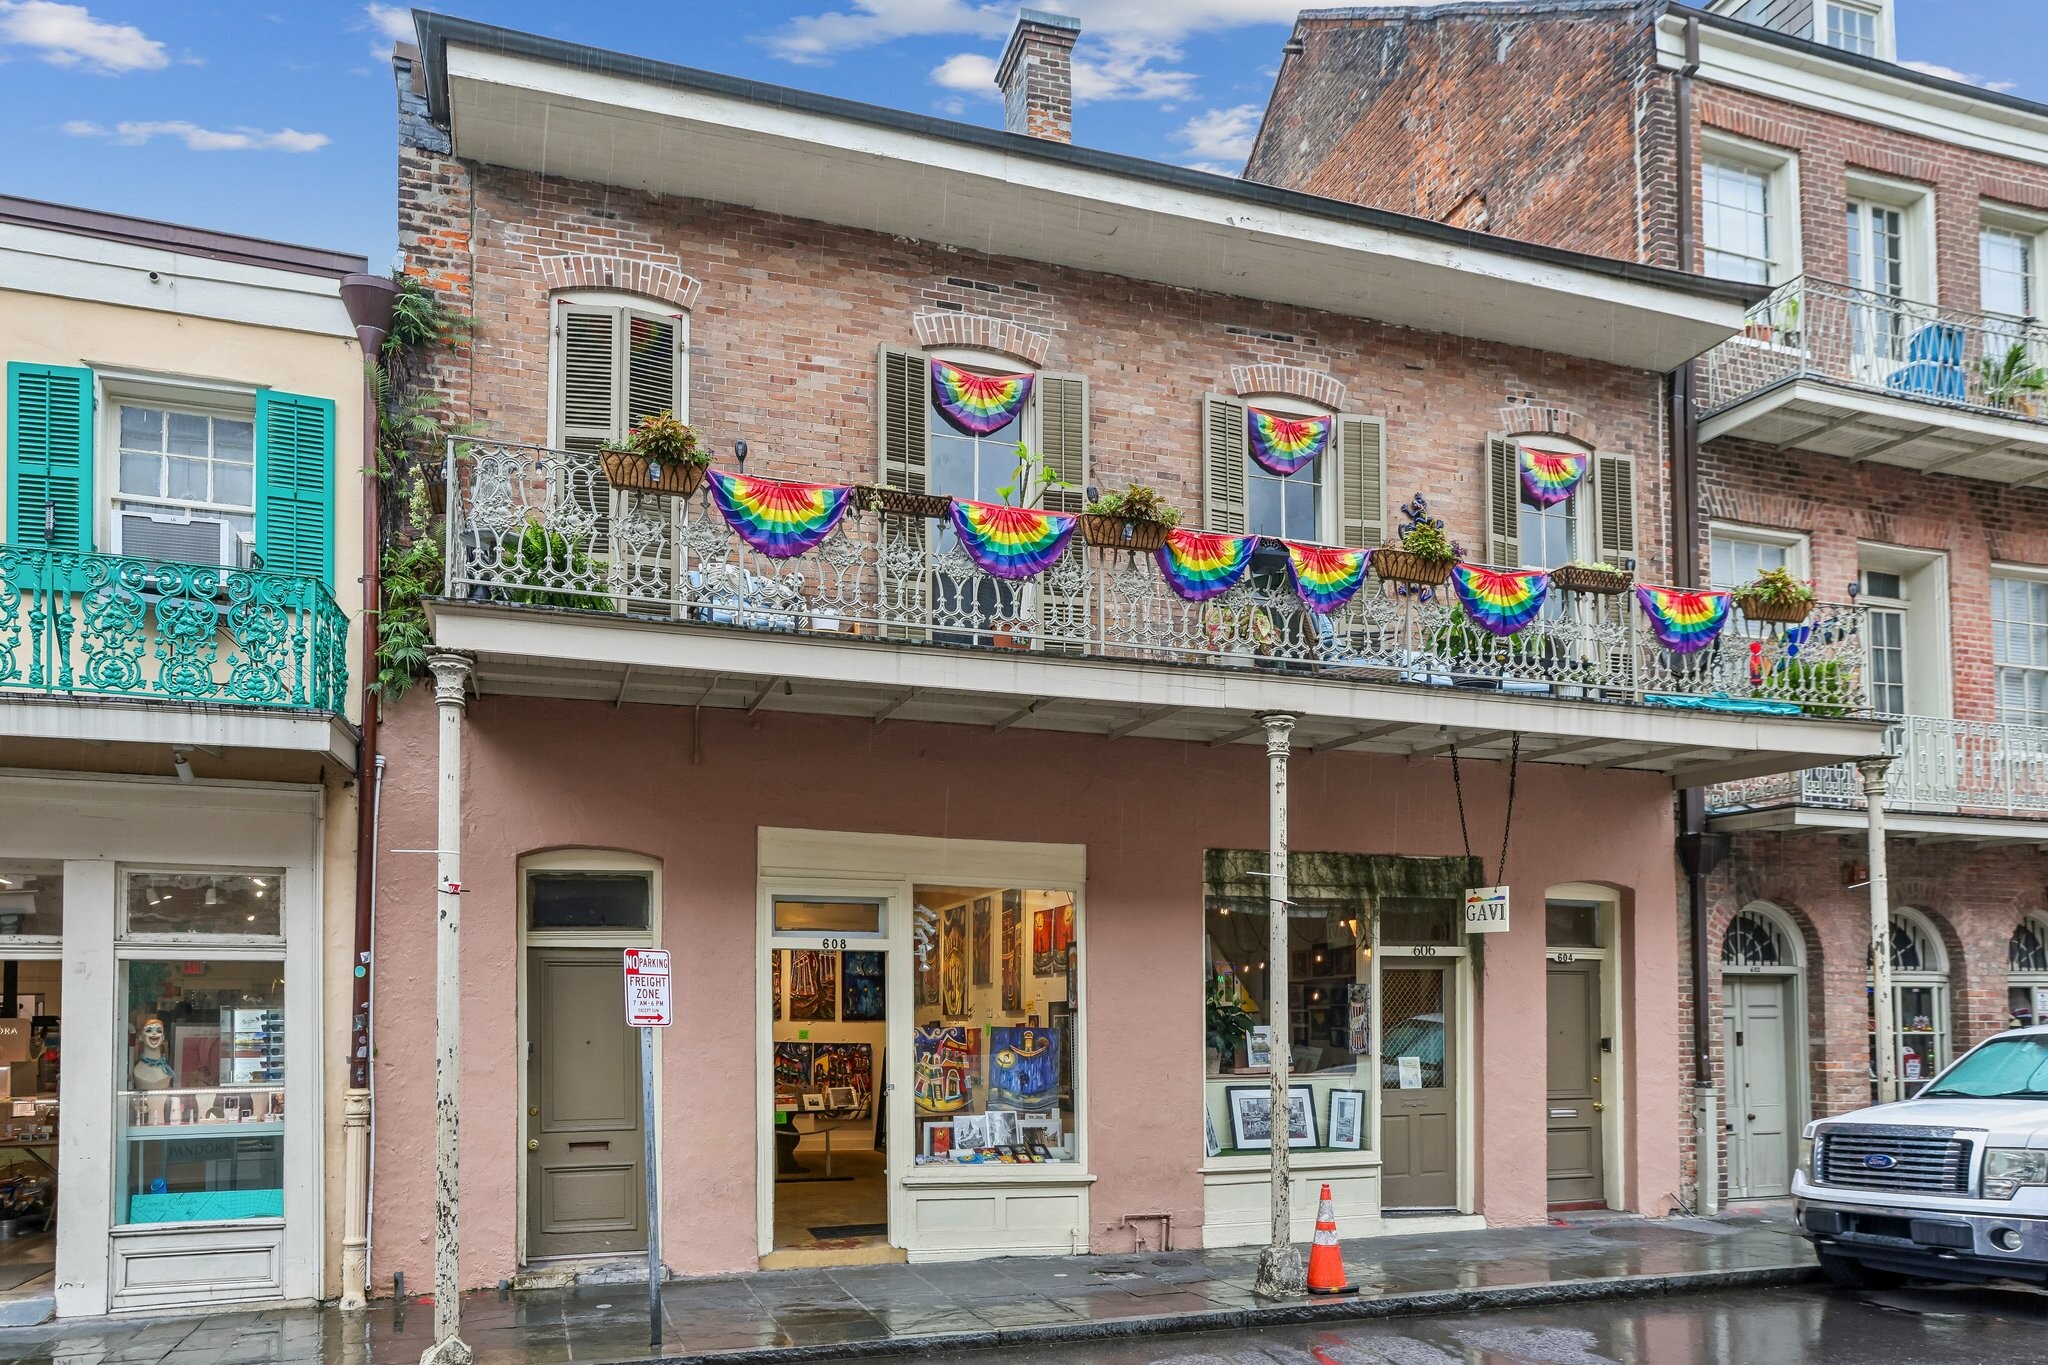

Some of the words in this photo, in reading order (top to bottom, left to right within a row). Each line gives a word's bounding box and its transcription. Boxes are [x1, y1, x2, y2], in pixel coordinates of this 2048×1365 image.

[1466, 903, 1506, 922] GAVI
[822, 938, 847, 949] 608
[1413, 944, 1436, 957] 606
[626, 955, 639, 969] NO
[639, 958, 668, 968] PARKING
[1557, 952, 1573, 962] 604
[630, 977, 666, 987] FREIGHT
[637, 989, 660, 999] ZONE
[1868, 1156, 1887, 1166] Ford
